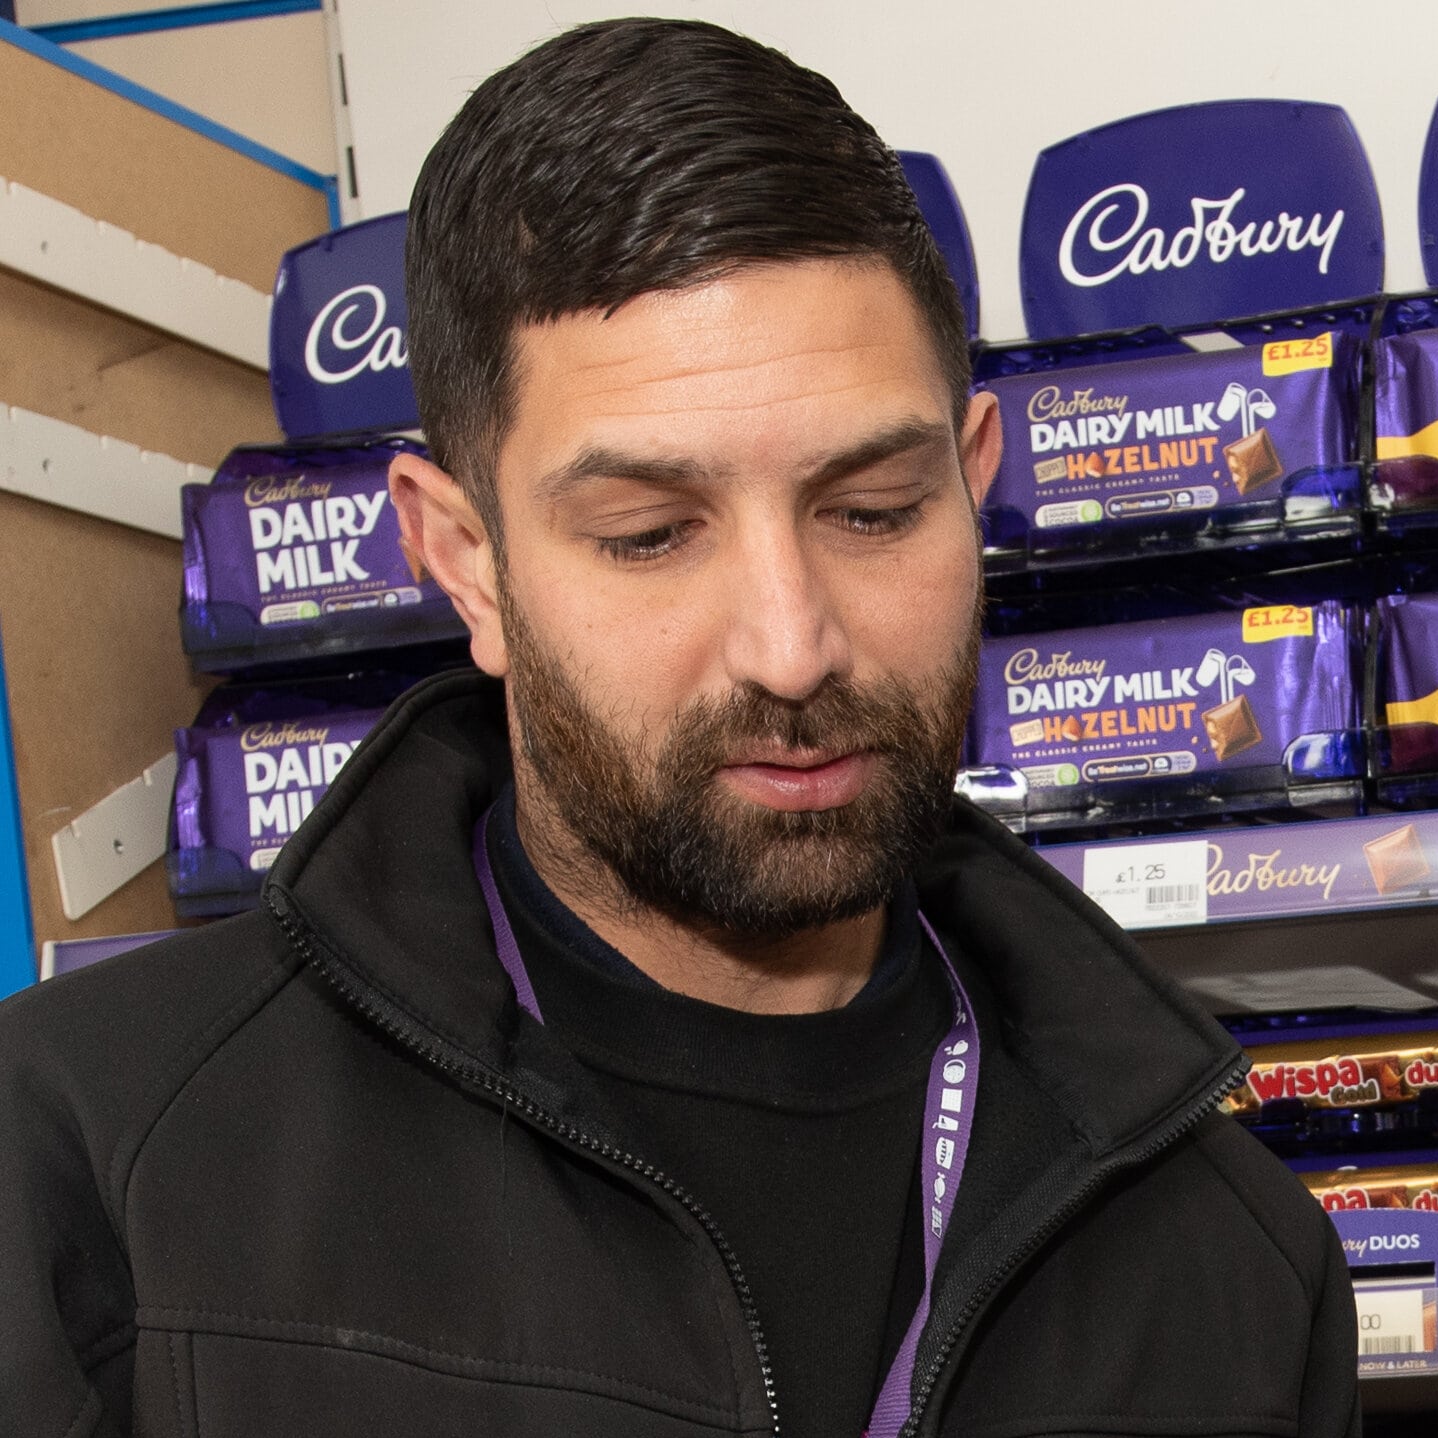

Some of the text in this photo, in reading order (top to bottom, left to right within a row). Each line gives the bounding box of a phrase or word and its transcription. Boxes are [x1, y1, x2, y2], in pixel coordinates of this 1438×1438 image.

[1059, 183, 1344, 287] Cadbury
[1267, 335, 1329, 361] £1.25
[1027, 385, 1129, 422] Cadbury
[1030, 402, 1221, 453] DAIRY MILK
[244, 475, 332, 507] Cadbury
[250, 490, 388, 550] DAIRY
[256, 539, 370, 594] MILK
[1247, 607, 1310, 629] £1.25
[1004, 648, 1106, 685] Cadbury
[1007, 667, 1200, 715] DAIRY MILK
[240, 722, 329, 751] Cadbury
[244, 740, 362, 794] DAIR
[1247, 1056, 1361, 1103] Wispa
[1369, 1234, 1420, 1251] DUOS
[1397, 1360, 1428, 1369] LATER
